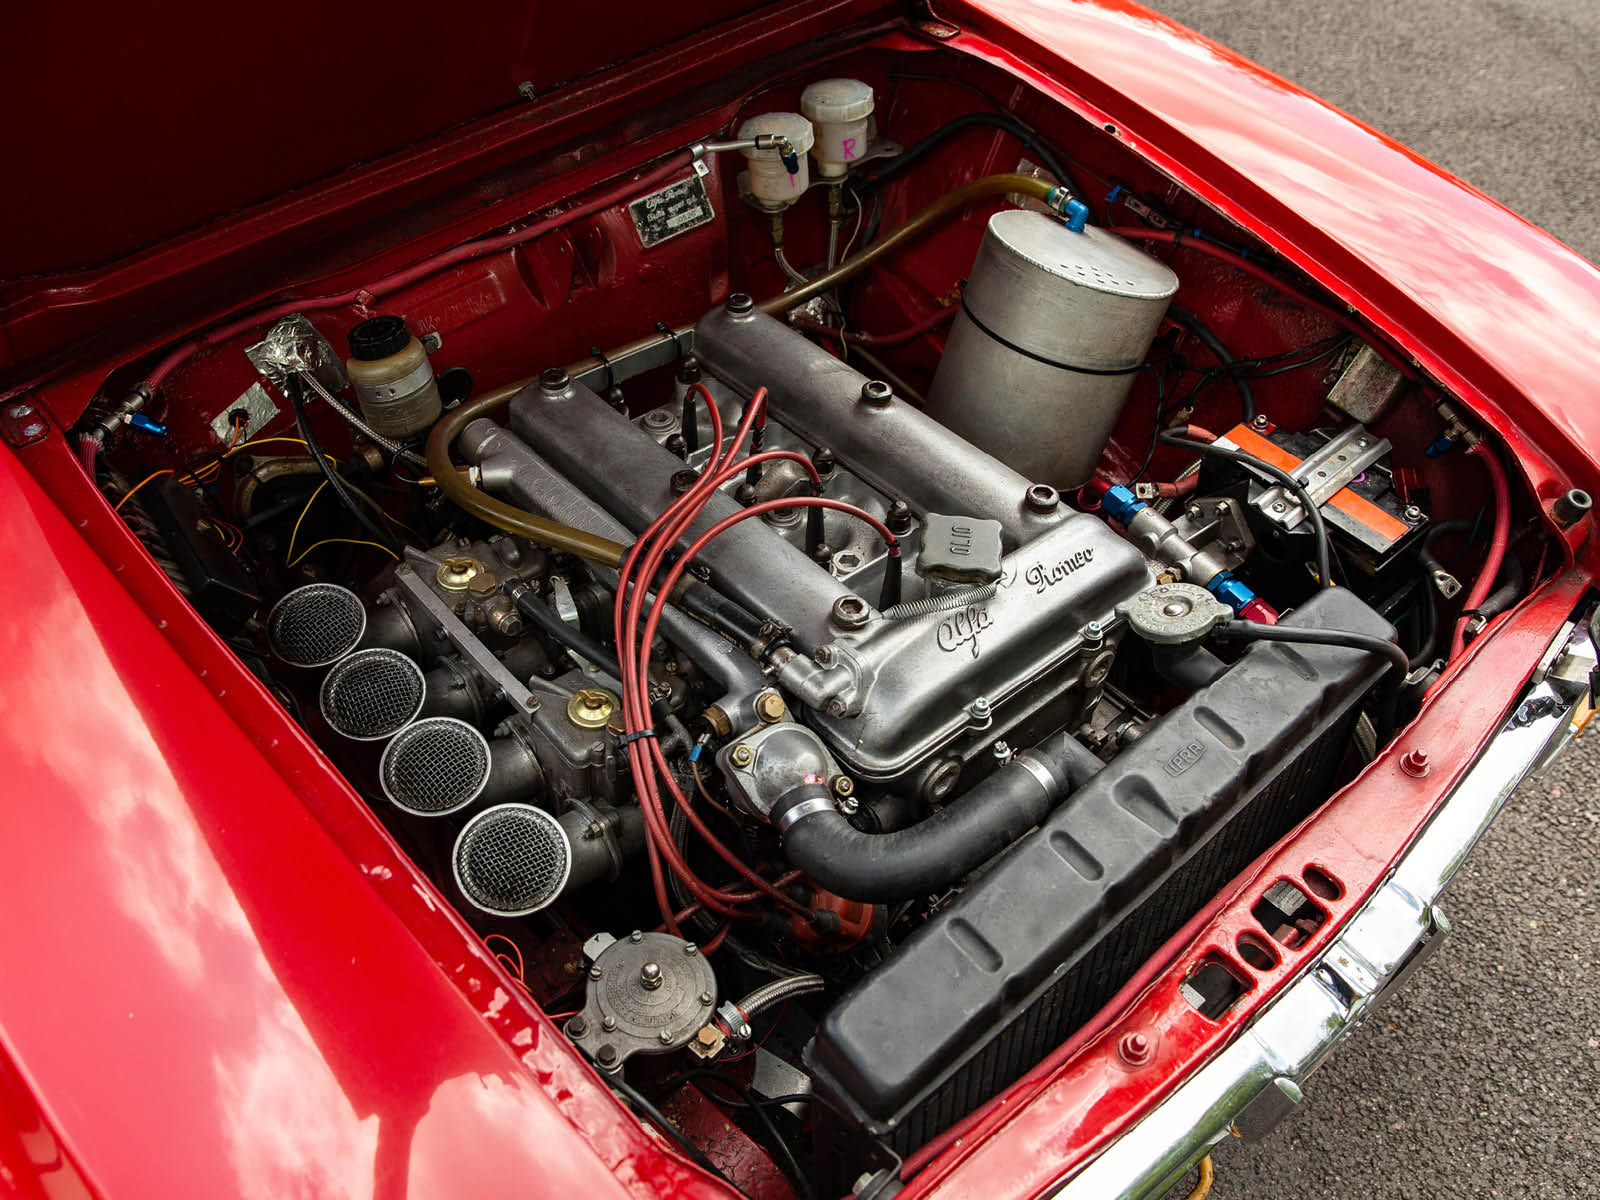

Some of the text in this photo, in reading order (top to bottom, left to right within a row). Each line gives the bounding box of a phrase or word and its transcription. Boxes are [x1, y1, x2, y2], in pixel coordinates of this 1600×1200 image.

[841, 137, 856, 161] R
[950, 526, 971, 556] OLIO
[937, 547, 1094, 659] Alfa Romeo
